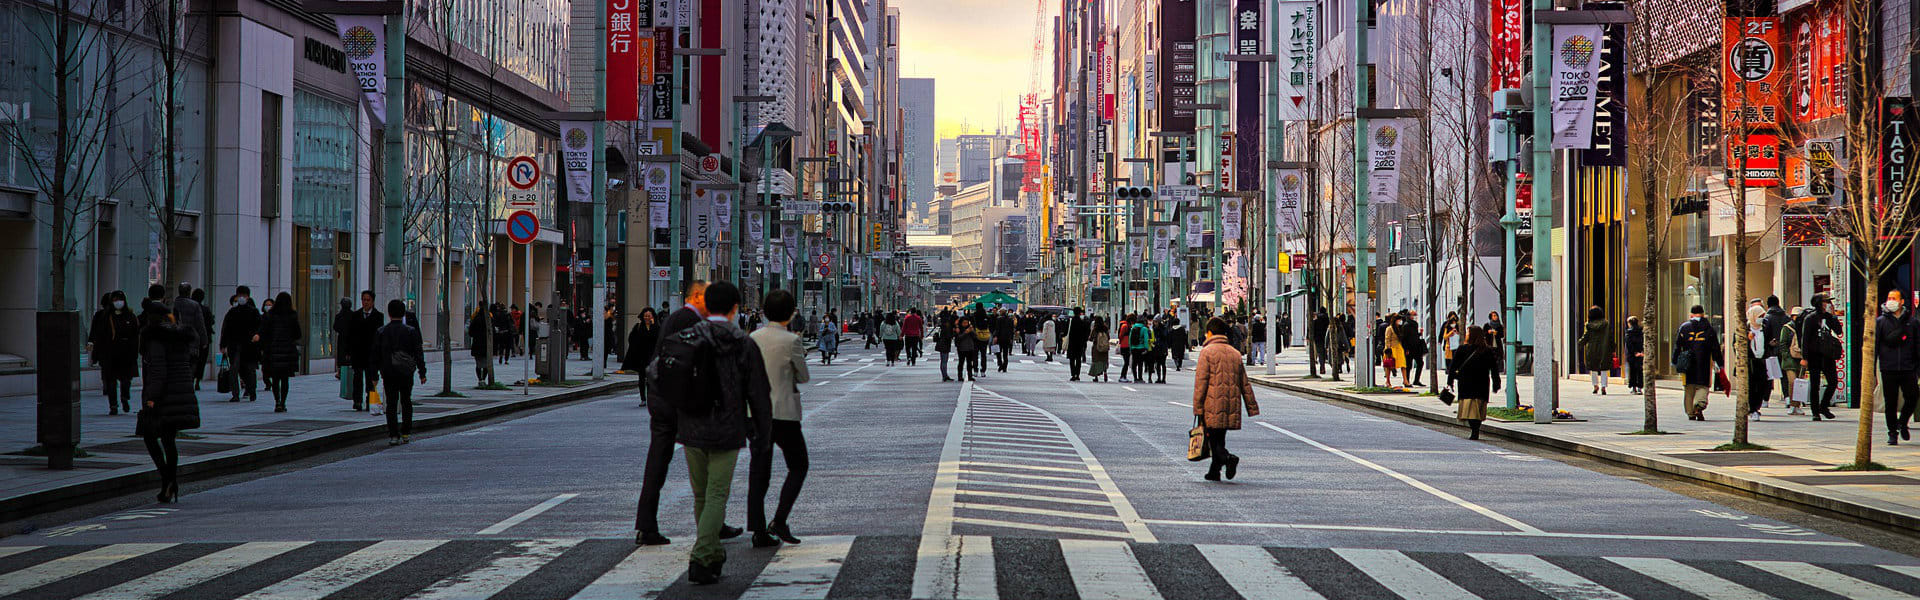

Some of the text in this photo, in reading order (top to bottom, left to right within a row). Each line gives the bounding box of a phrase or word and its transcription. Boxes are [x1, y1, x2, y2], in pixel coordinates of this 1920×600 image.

[1747, 21, 1778, 35] 2F
[1290, 11, 1305, 86] ナルニア国
[1561, 71, 1591, 80] TOKYO
[361, 78, 377, 88] 20
[1146, 60, 1154, 103] TASAKI
[1559, 86, 1588, 97] 2020
[566, 151, 588, 160] TOKYO
[1375, 149, 1396, 157] TOKYO
[1374, 159, 1395, 168] 2020
